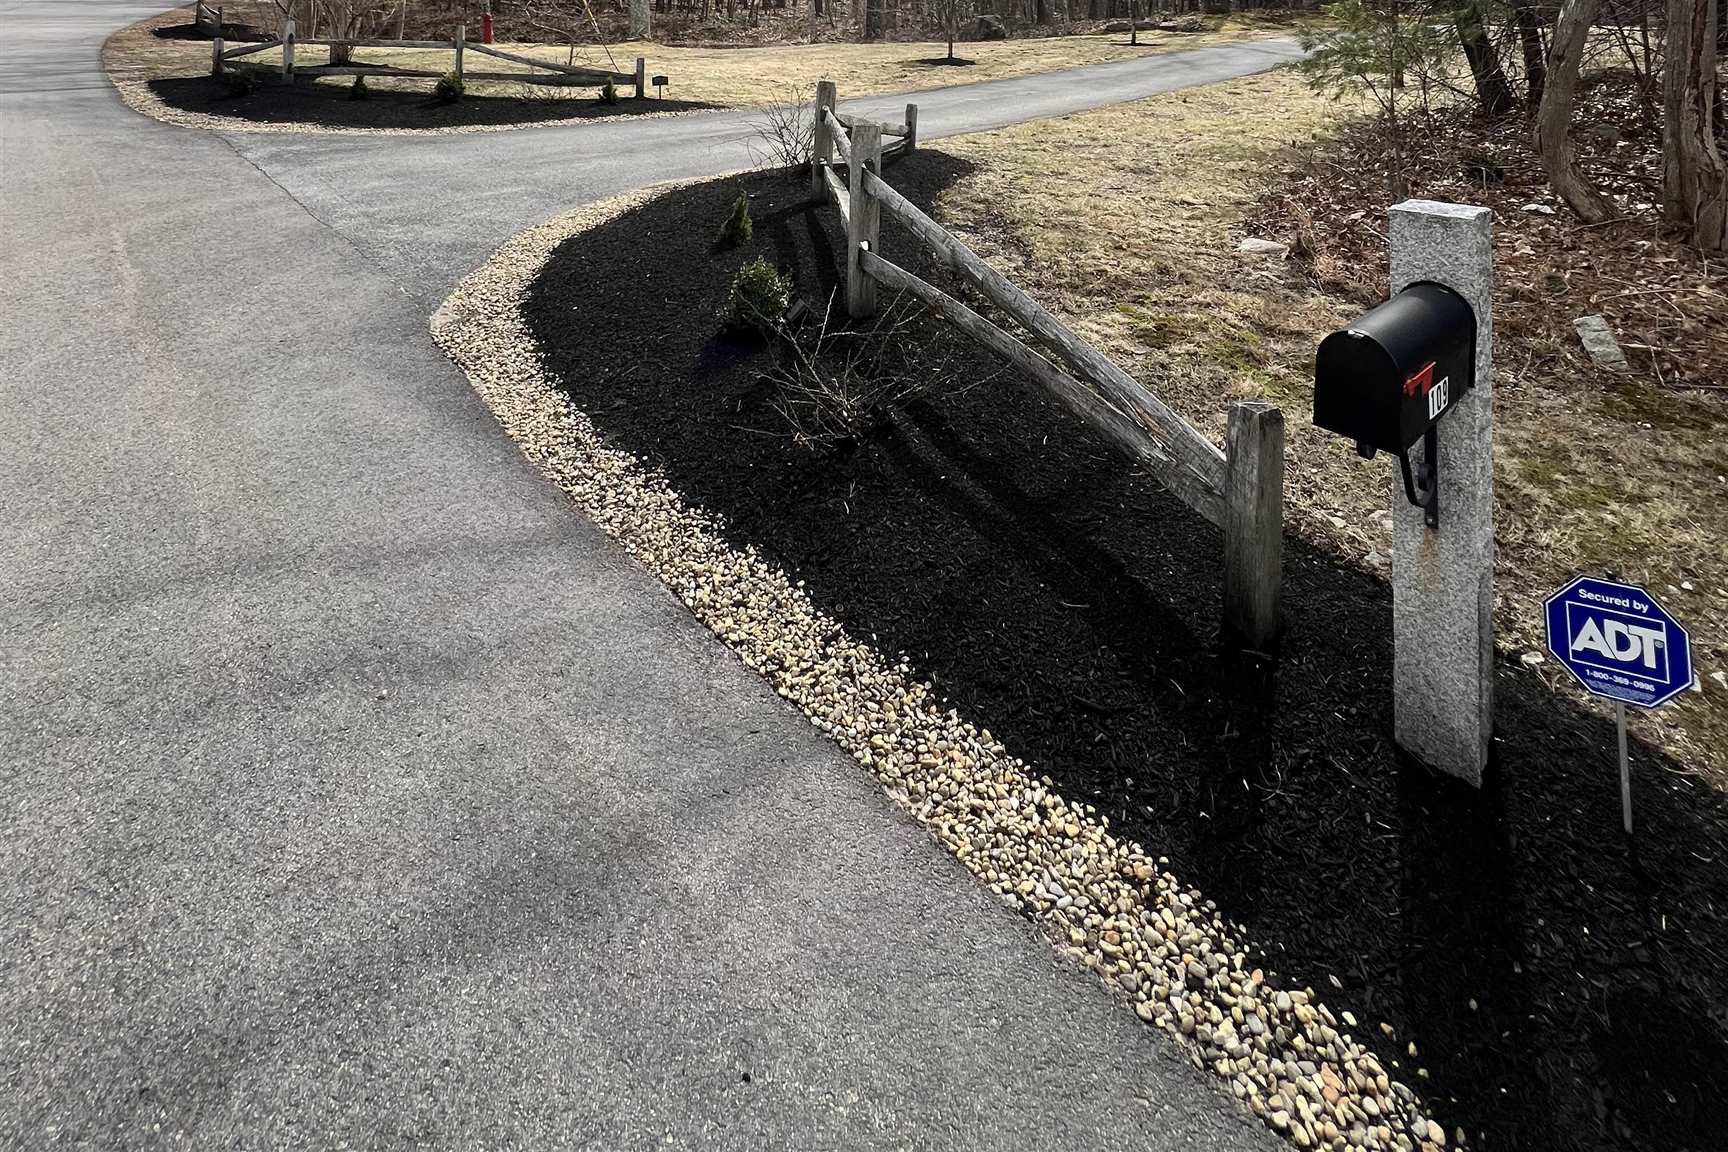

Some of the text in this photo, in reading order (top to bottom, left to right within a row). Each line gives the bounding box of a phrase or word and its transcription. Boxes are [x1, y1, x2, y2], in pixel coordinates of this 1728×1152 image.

[1431, 379, 1447, 415] 109
[1578, 588, 1649, 613] Secured by
[1571, 616, 1665, 669] ADT
